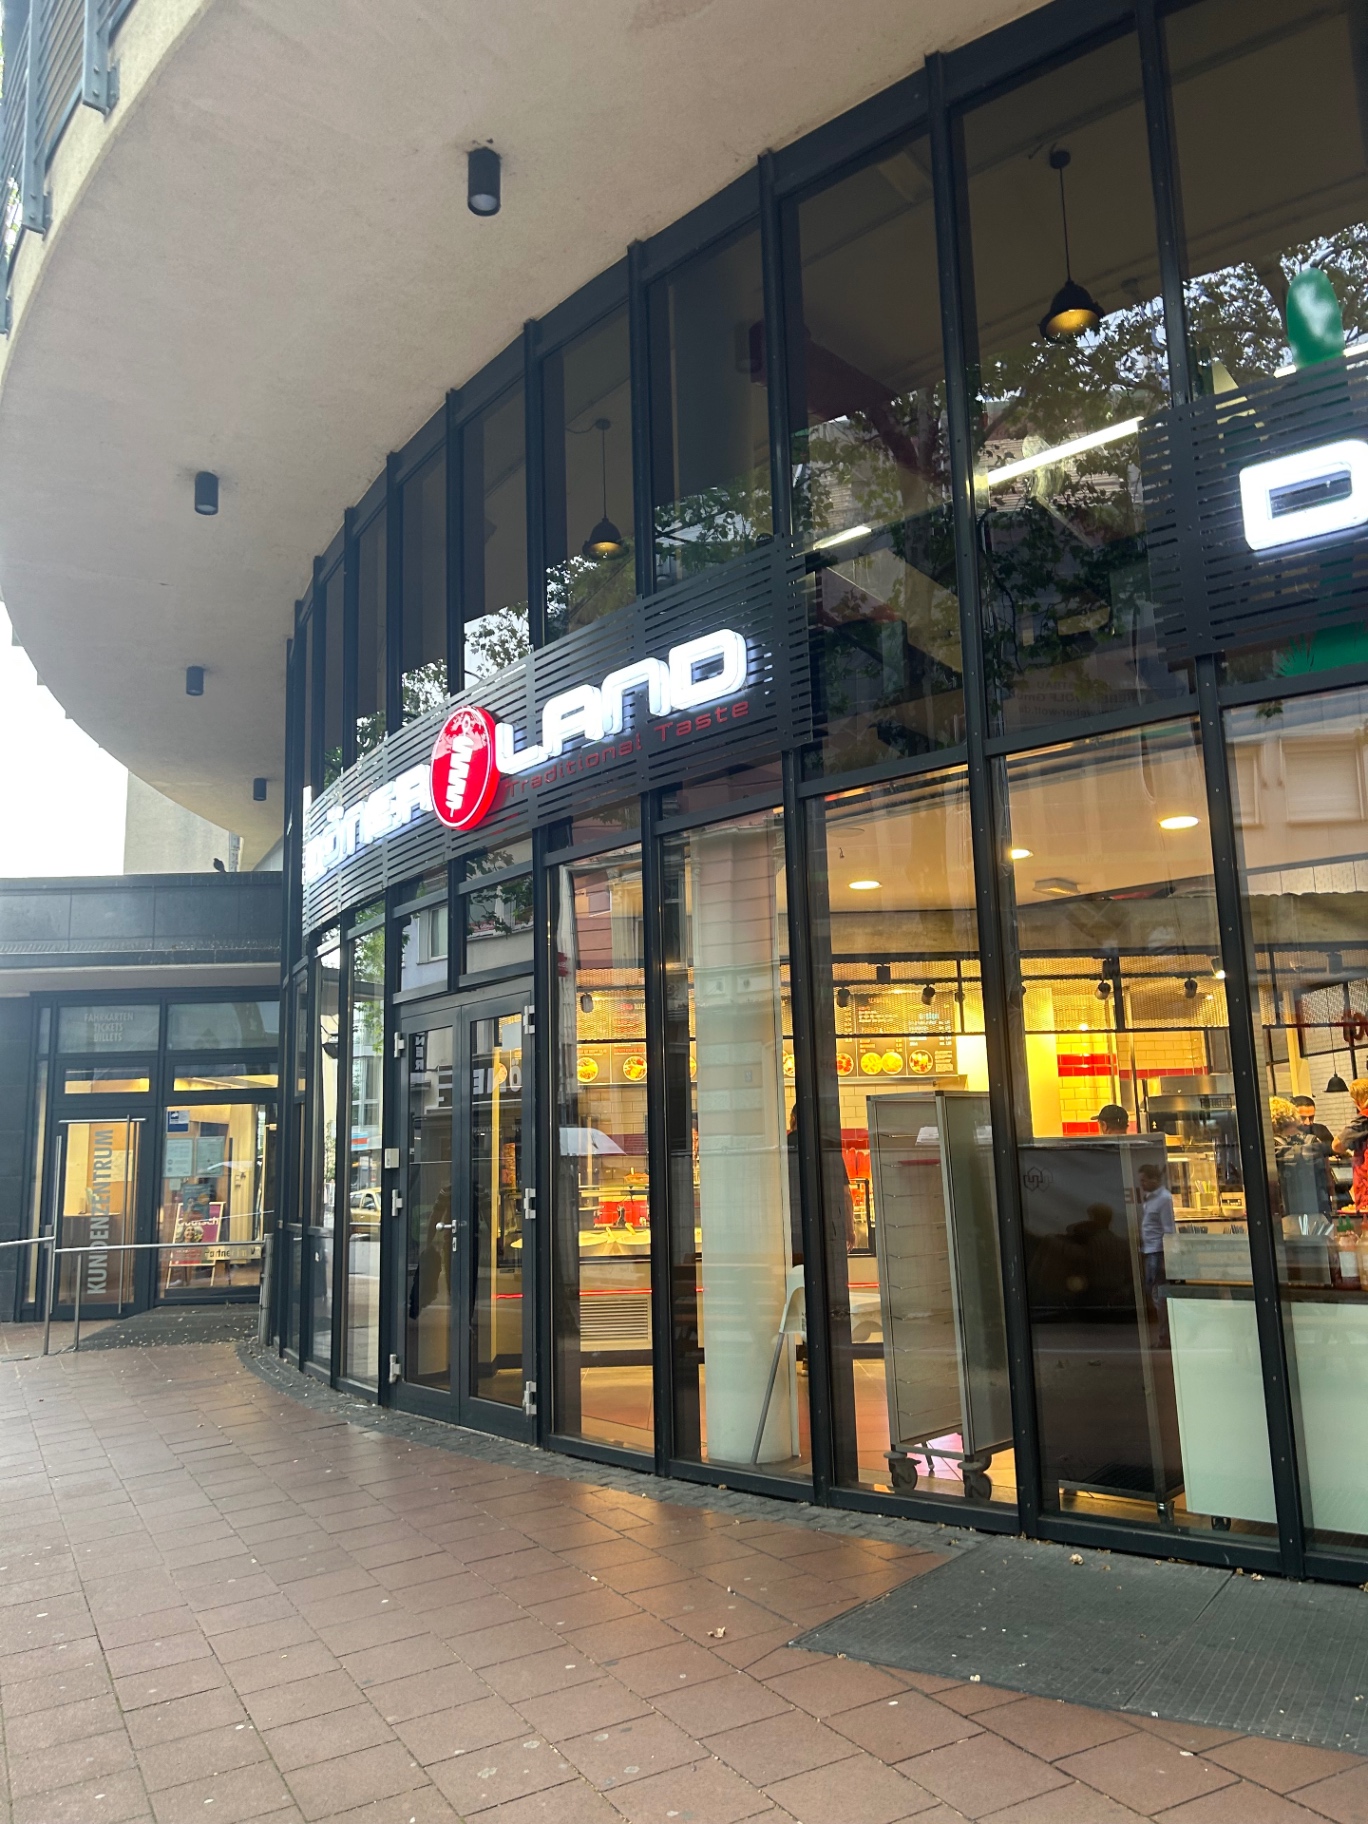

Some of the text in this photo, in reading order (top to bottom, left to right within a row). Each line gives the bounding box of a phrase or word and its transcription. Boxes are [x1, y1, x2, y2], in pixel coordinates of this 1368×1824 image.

[495, 628, 748, 775] LAND
[505, 700, 750, 798] Traditional Taste
[84, 1012, 134, 1022] FAHRKARTEN
[93, 1022, 124, 1033] TICKETS
[93, 1032, 123, 1042] BILLETS
[87, 1129, 114, 1295] KUNDENZENTRUM
